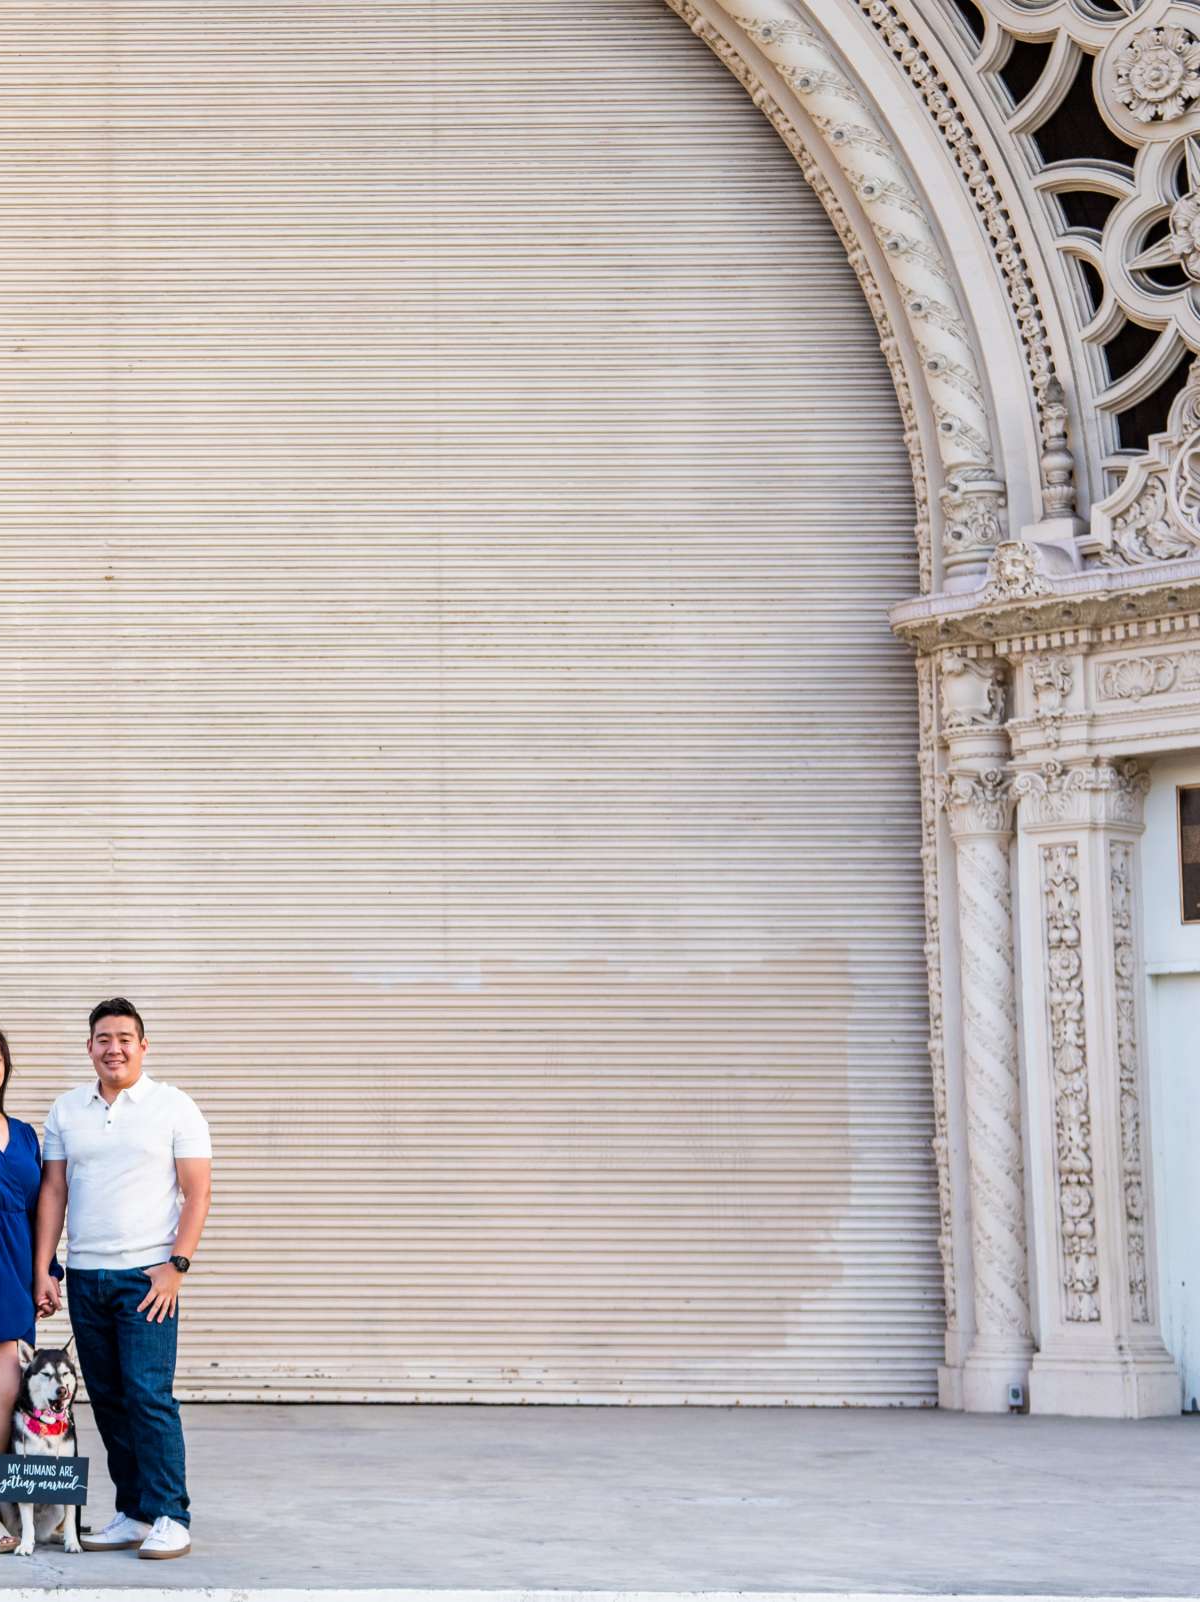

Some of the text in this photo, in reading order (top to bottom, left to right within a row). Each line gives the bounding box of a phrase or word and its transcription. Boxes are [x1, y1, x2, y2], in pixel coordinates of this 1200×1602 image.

[7, 1463, 74, 1477] MY HUMANS ARE
[38, 1475, 88, 1491] married
